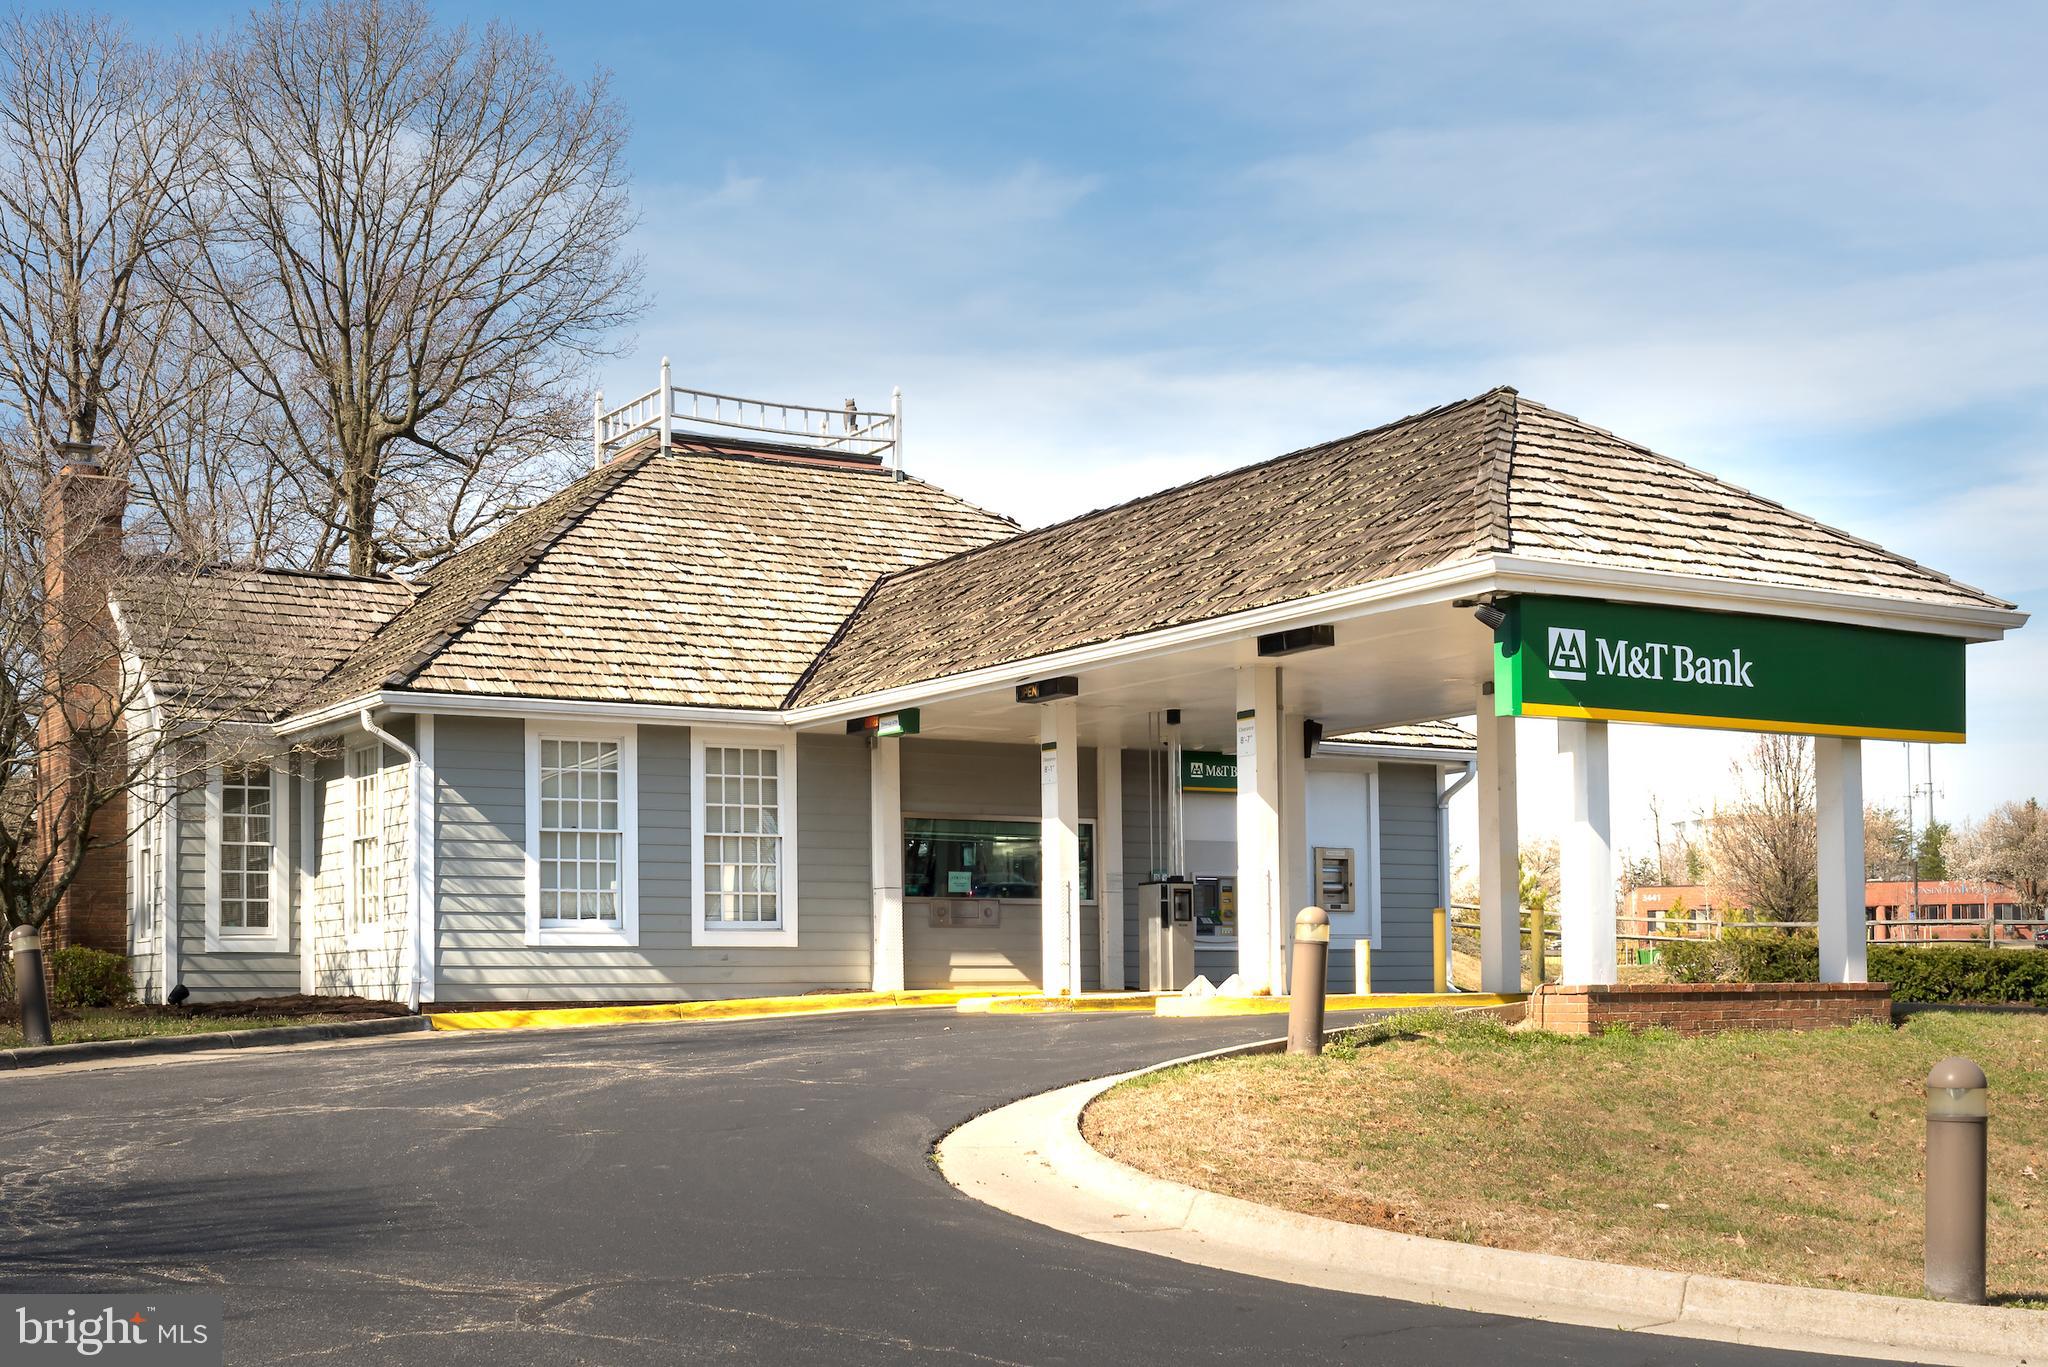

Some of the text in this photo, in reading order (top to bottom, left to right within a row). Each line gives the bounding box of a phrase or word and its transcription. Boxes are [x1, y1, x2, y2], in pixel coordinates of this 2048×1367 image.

[1595, 637, 1754, 688] M&T Bank
[1205, 764, 1230, 777] M&T
